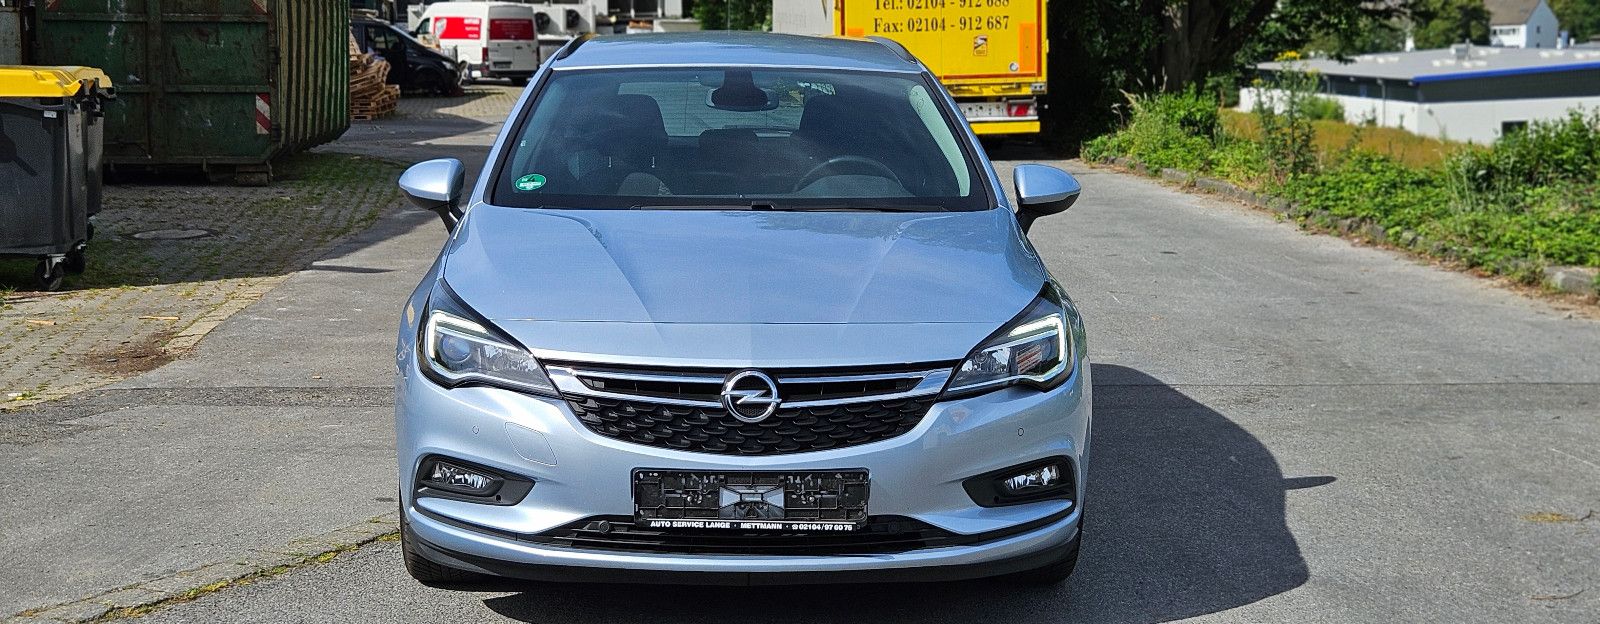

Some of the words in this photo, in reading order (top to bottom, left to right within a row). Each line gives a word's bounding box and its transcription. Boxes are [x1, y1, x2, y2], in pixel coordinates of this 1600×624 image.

[873, 17, 903, 33] Fax:
[907, 17, 946, 32] 02104
[959, 16, 982, 31] 912
[986, 15, 1009, 30] 687
[705, 521, 731, 529] LANGE
[740, 522, 782, 530] METTMANN
